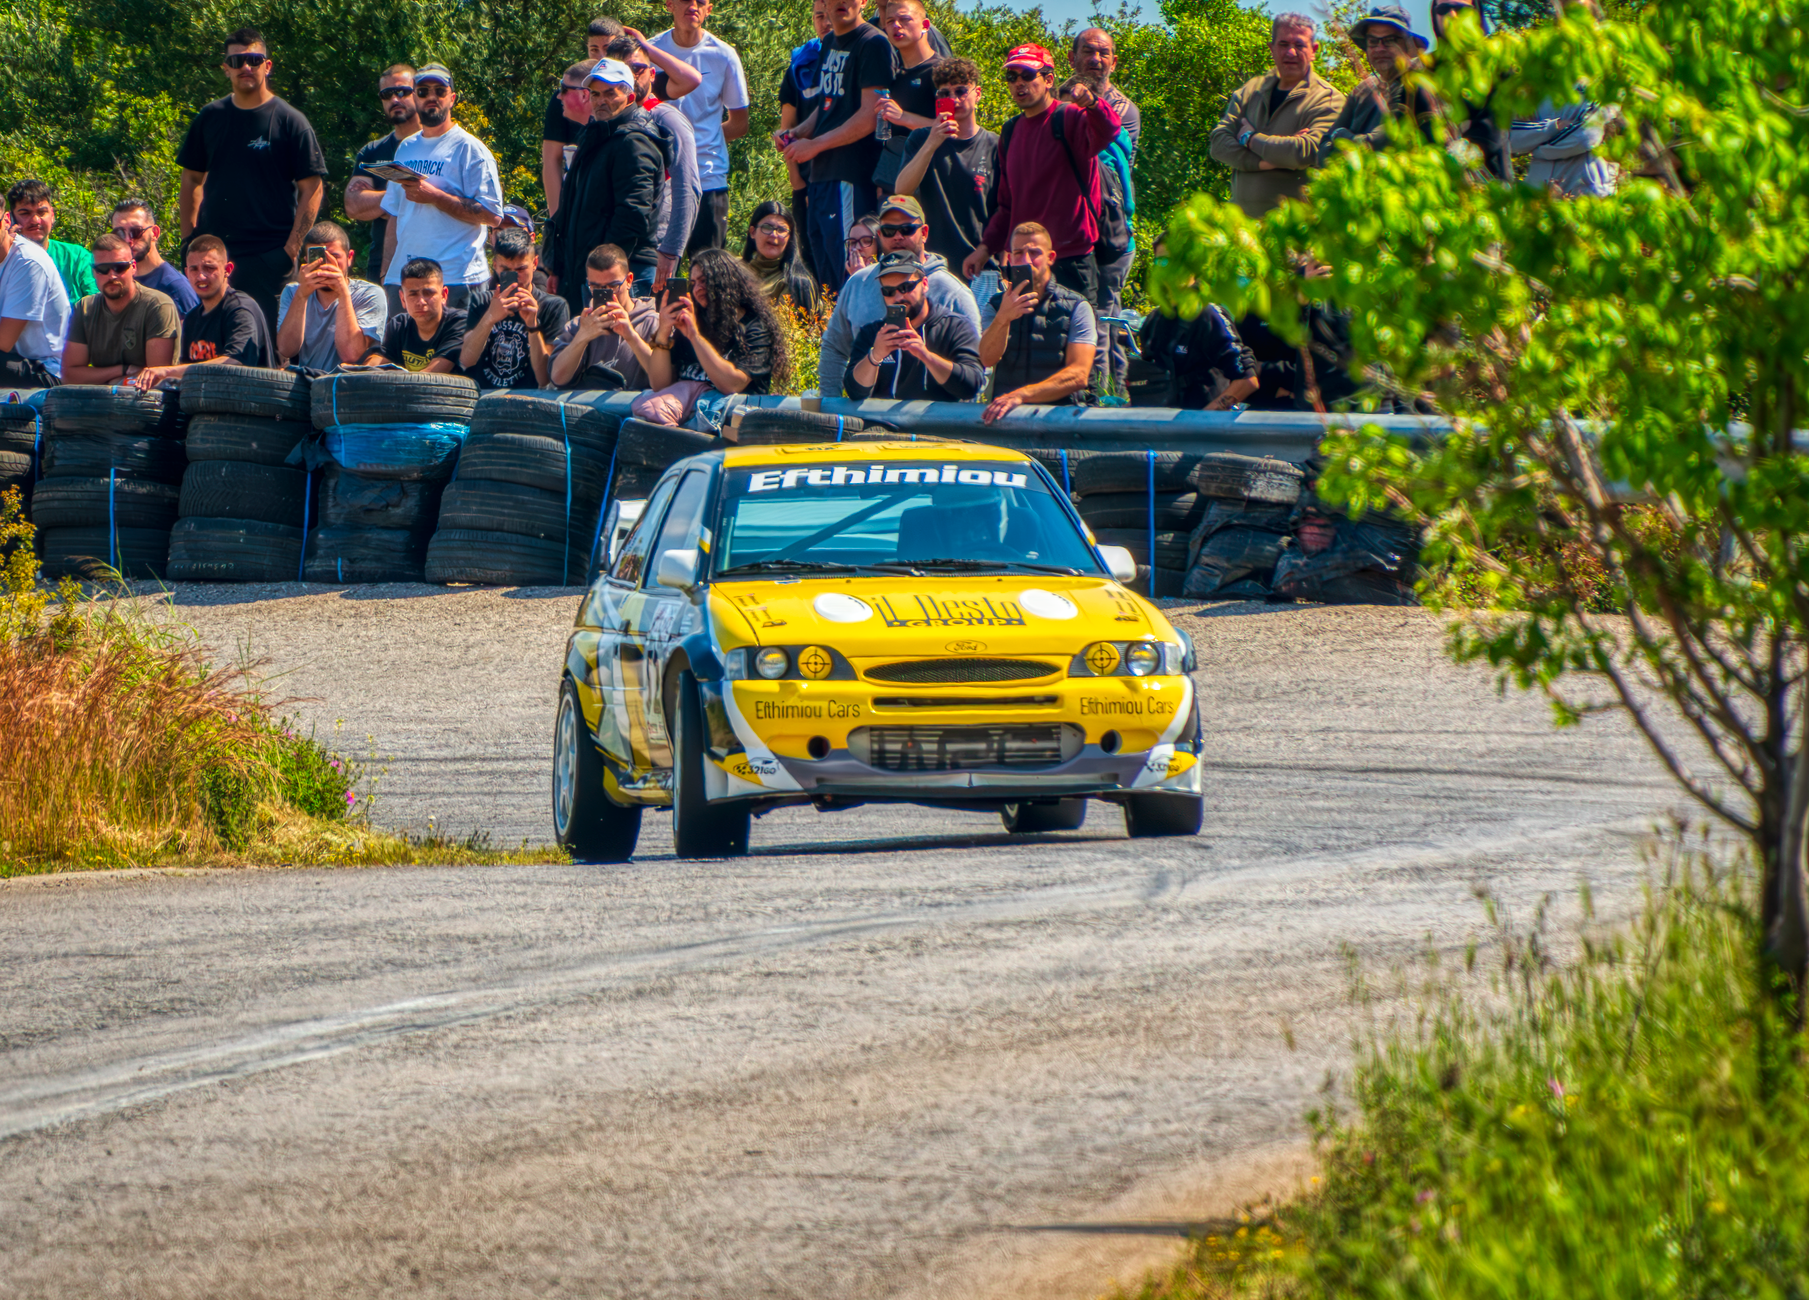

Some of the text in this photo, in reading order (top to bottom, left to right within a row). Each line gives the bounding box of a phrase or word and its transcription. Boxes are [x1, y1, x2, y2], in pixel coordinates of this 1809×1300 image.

[822, 48, 851, 73] JUST
[748, 465, 1028, 493] Efthimiou
[904, 617, 1008, 628] GROUP
[755, 699, 861, 720] Efthimiou Cars
[1080, 695, 1174, 716] Efthimiou Cars
